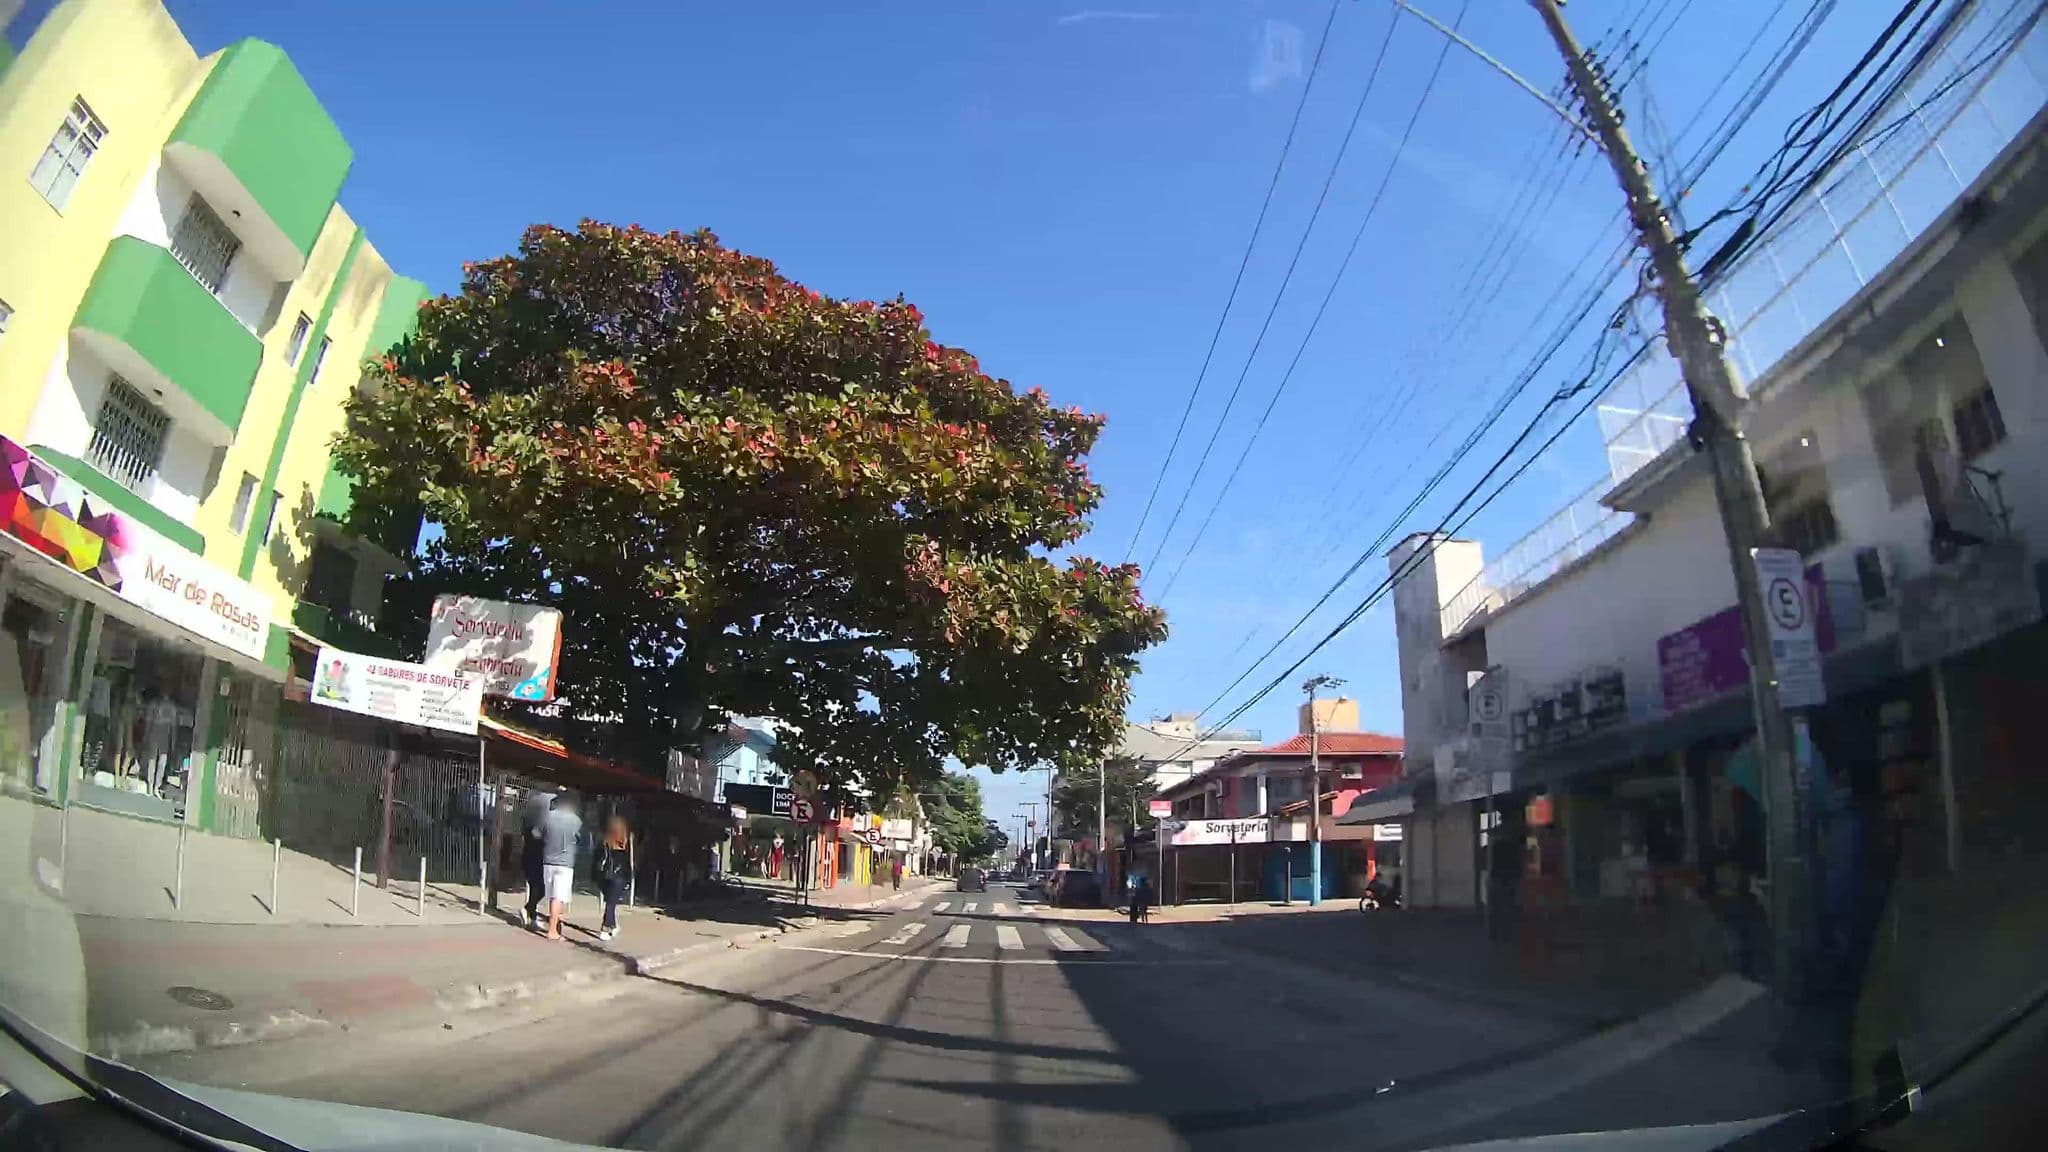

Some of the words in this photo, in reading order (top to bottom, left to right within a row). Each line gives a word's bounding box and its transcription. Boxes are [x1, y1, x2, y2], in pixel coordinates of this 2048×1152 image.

[145, 555, 182, 593] Mar
[185, 580, 207, 605] de
[211, 592, 260, 632] Rosas
[378, 666, 415, 681] SABORES
[416, 673, 428, 683] DE
[430, 674, 471, 690] SORVETE
[1206, 822, 1268, 834] Sorveteria
